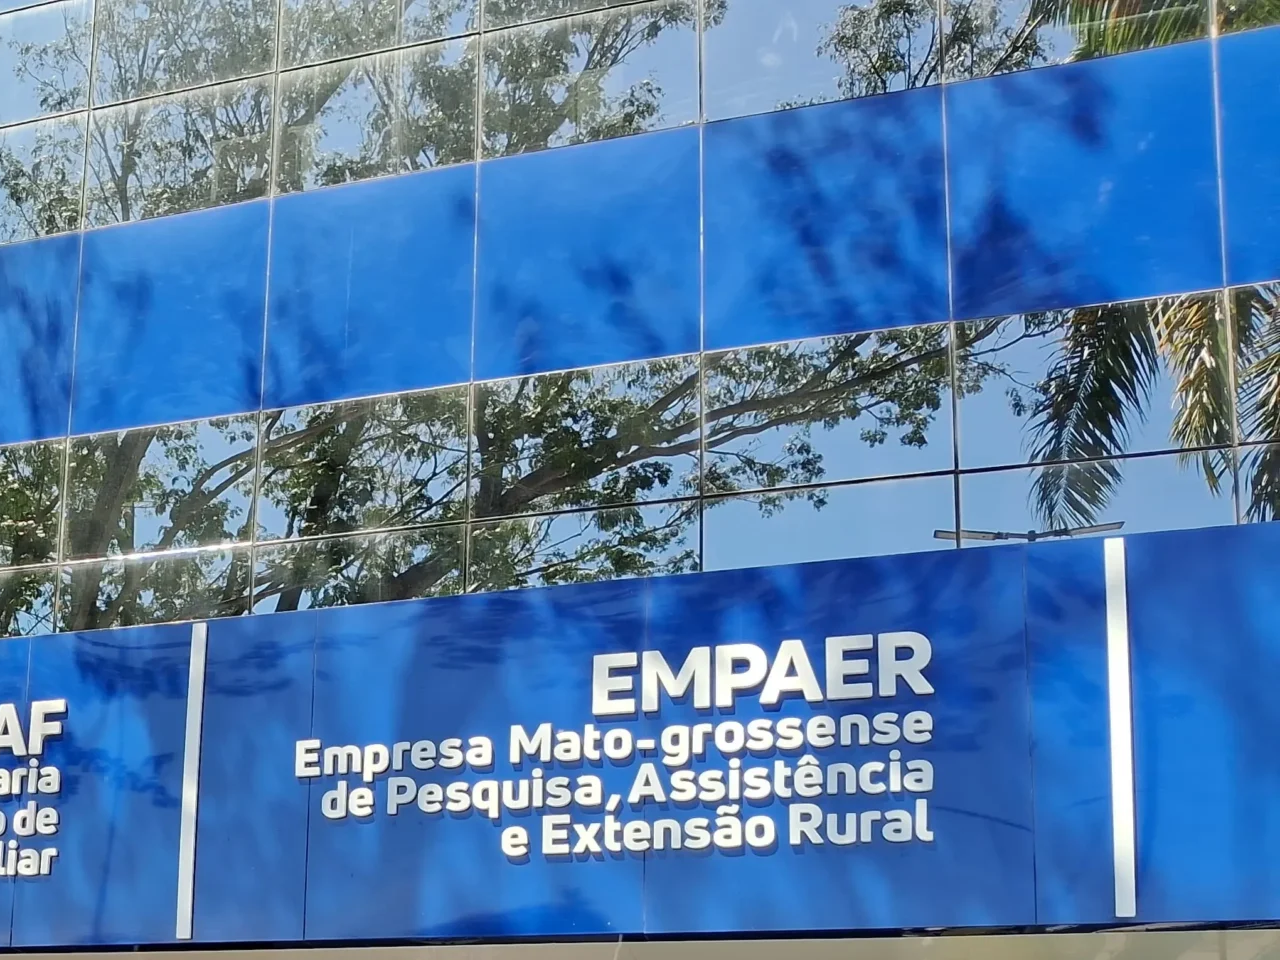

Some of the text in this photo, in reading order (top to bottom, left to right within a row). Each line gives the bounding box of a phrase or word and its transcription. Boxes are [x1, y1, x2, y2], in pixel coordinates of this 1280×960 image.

[591, 630, 935, 716] EMPAER
[294, 707, 934, 782] Empresa Mato-grossense
[12, 800, 60, 836] de
[321, 750, 935, 822] de Pesquisa, Assistência
[500, 798, 935, 857] e Extensão Rural
